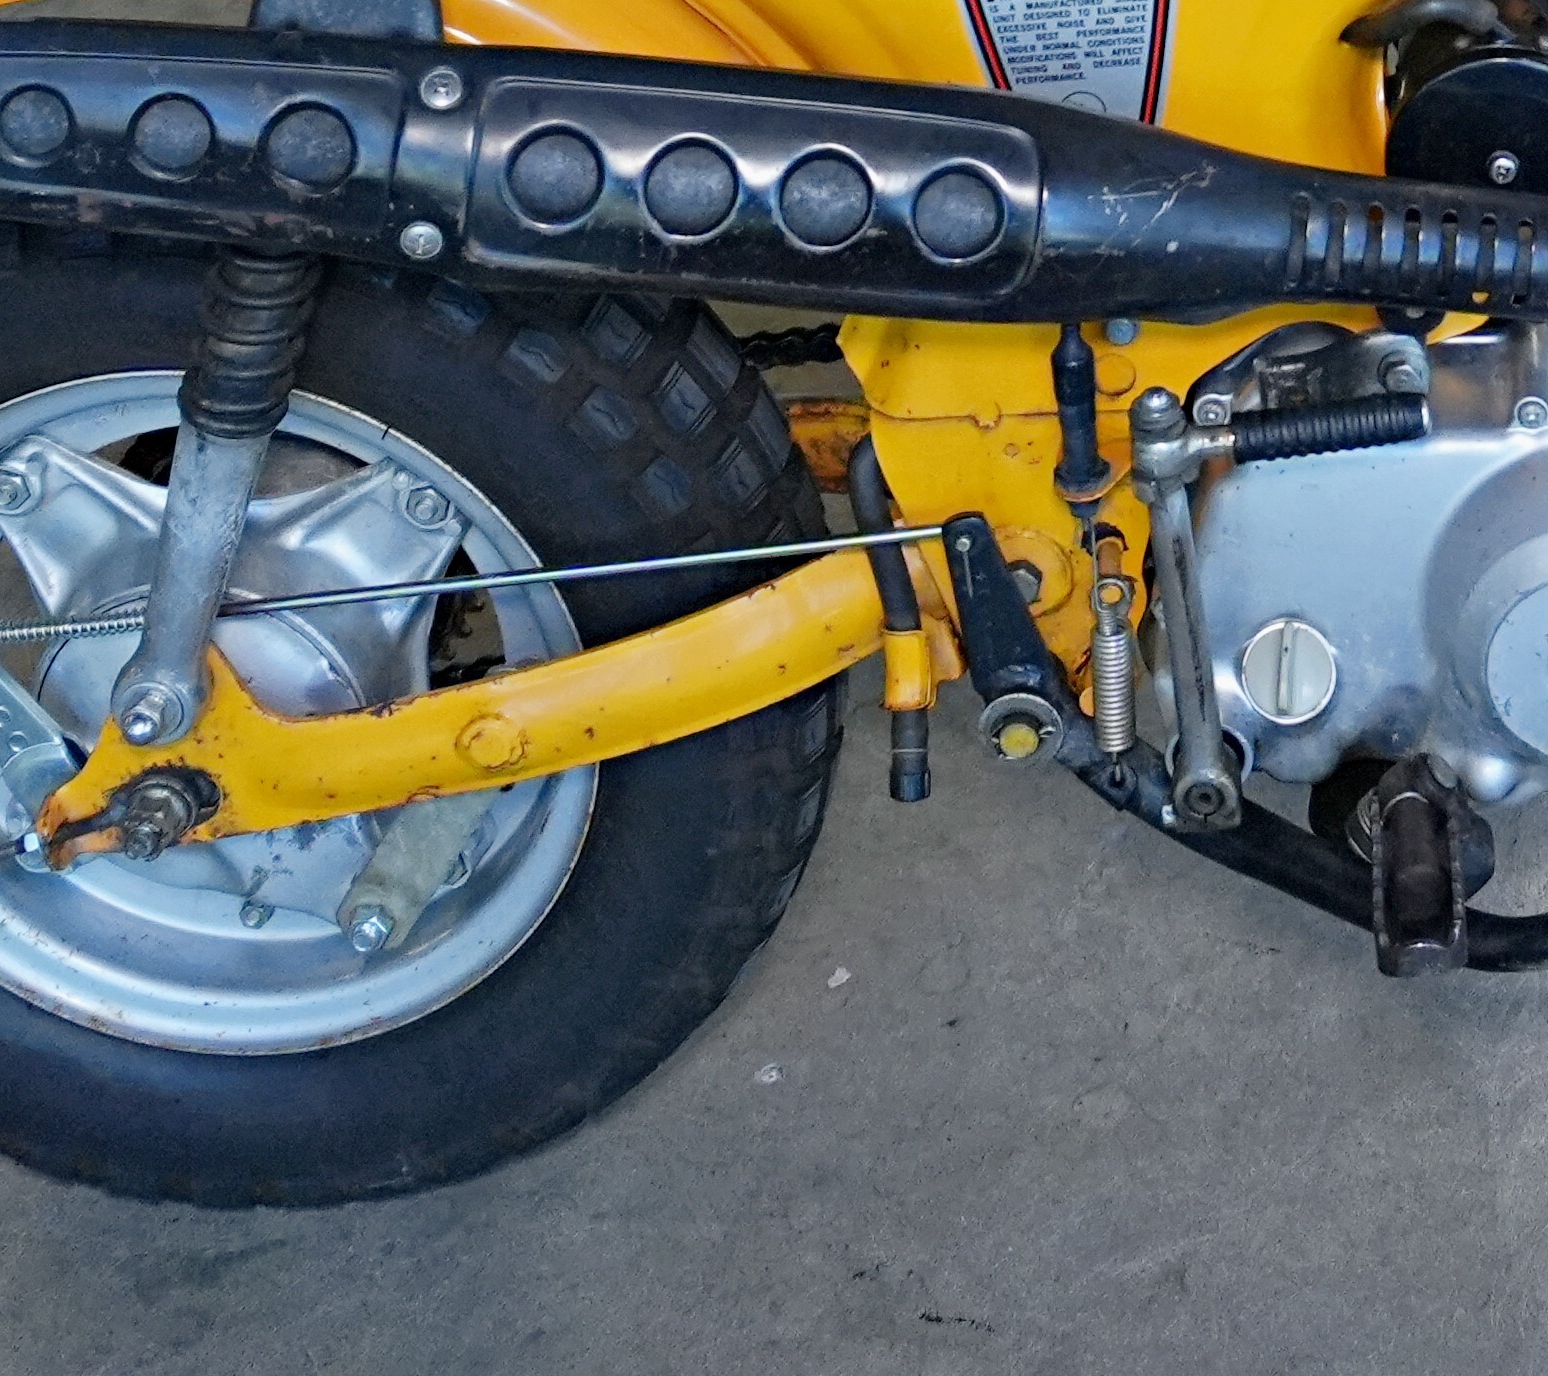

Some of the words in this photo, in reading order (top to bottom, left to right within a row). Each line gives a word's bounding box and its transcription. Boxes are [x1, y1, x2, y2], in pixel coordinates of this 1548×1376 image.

[1009, 3, 1015, 11] A
[1023, 10, 1071, 20] DESIGNED
[1078, 8, 1090, 17] TO
[1097, 4, 1148, 15] ELIMINATE
[997, 23, 1047, 33] EXCESSIVE
[1057, 20, 1085, 28] NOISE
[1096, 18, 1114, 26] AND
[1036, 32, 1059, 41] BEST
[1076, 27, 1146, 38] PERFORMANCE
[1111, 47, 1143, 56] AFFECT
